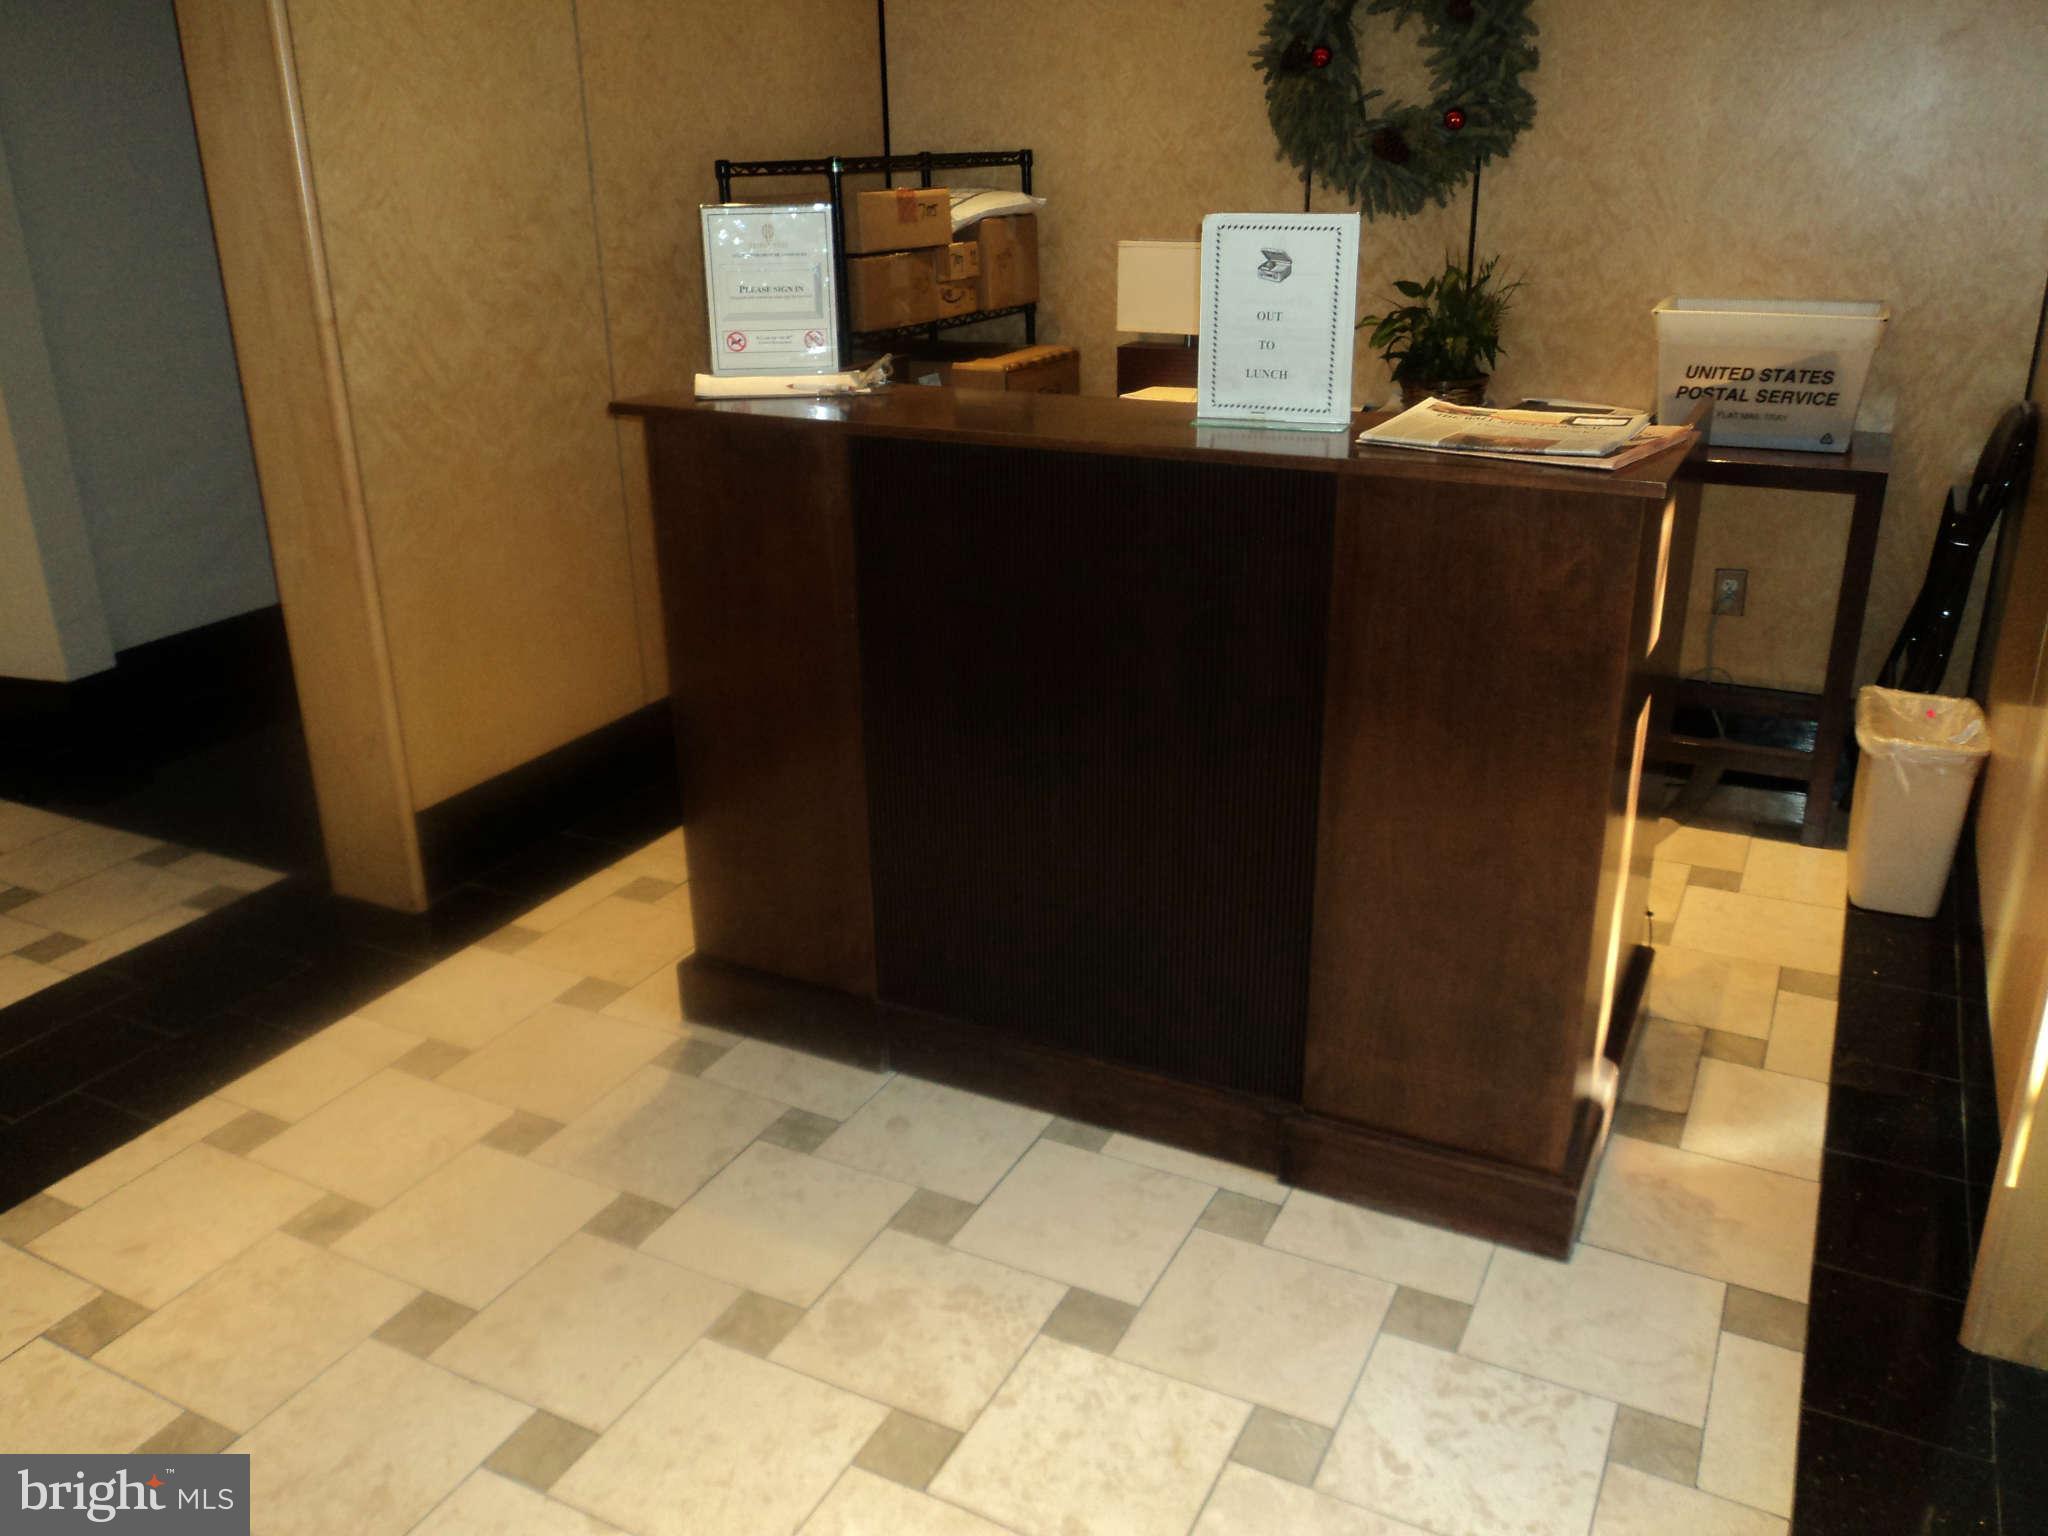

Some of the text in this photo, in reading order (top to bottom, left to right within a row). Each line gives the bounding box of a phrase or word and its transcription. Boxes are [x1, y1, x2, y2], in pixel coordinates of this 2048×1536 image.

[1256, 311, 1283, 321] OUT
[1258, 340, 1275, 350] TO
[1246, 368, 1288, 380] LUNCH
[1686, 364, 1836, 385] UNITED STATES
[1675, 385, 1841, 407] POSTAL SERVICE
